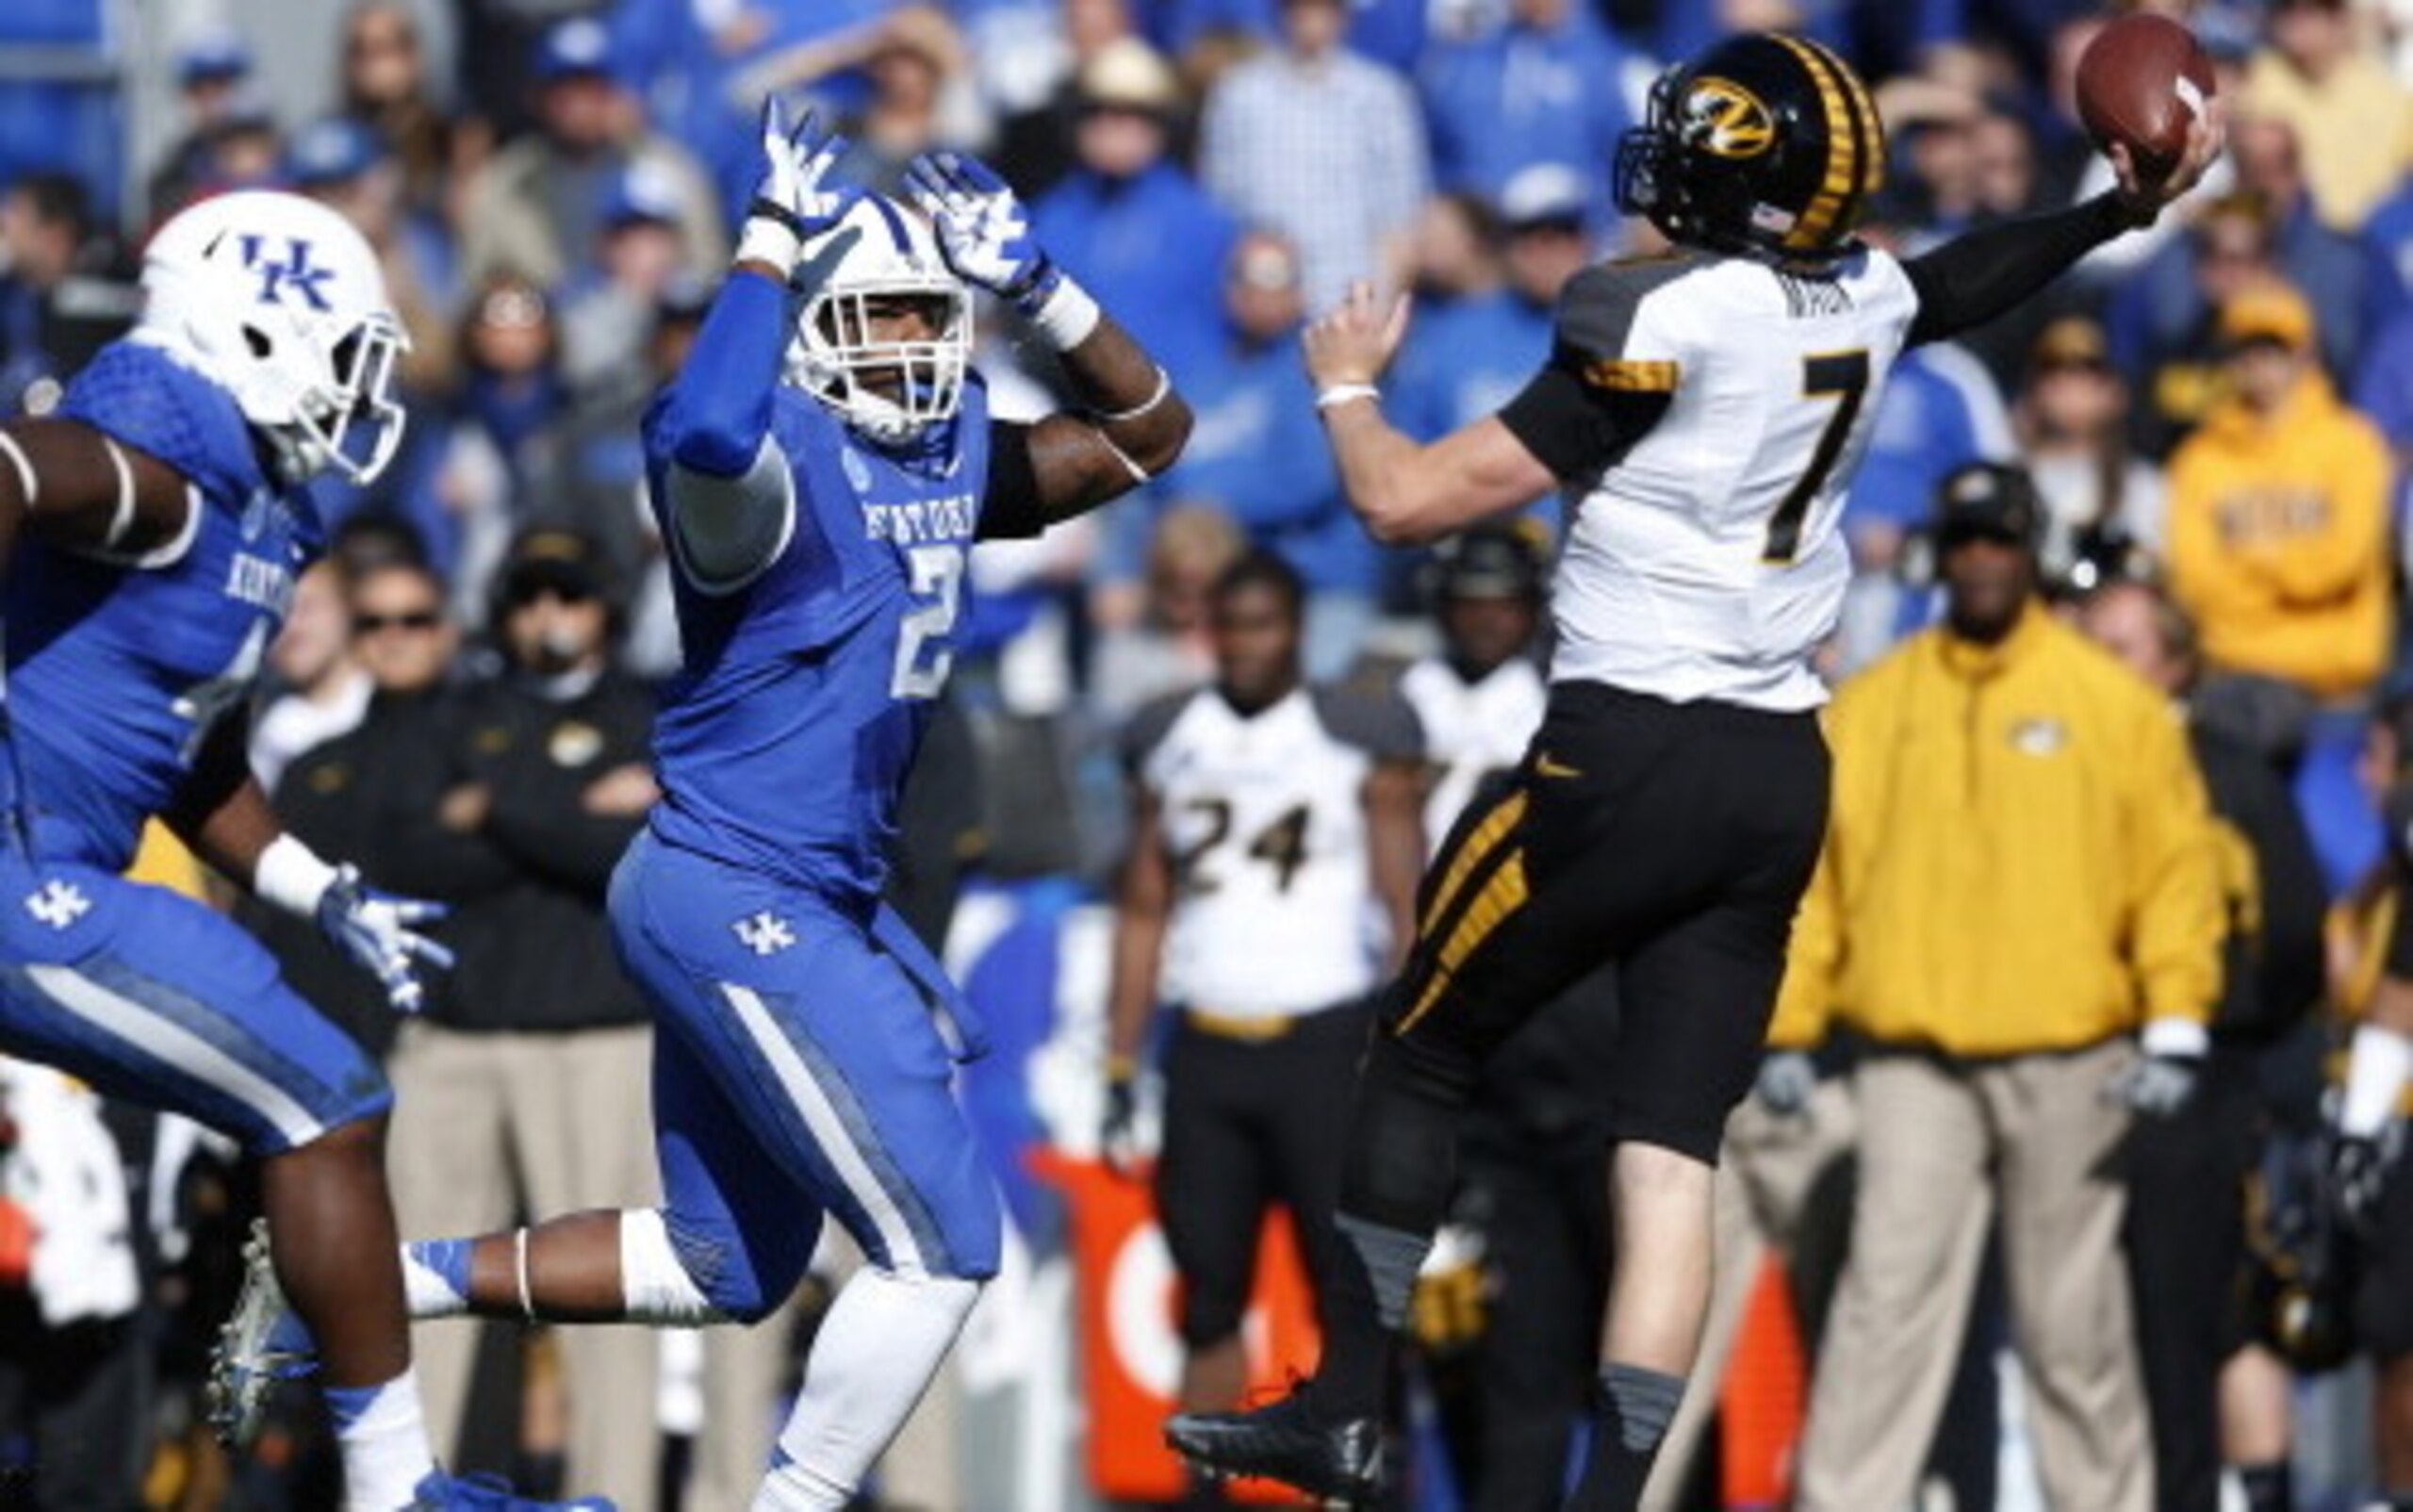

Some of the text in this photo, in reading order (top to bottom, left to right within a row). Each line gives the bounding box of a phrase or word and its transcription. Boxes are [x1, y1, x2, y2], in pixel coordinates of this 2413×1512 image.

[1759, 346, 1870, 568] 7
[890, 544, 963, 699] 2
[1169, 797, 1311, 894] 24
